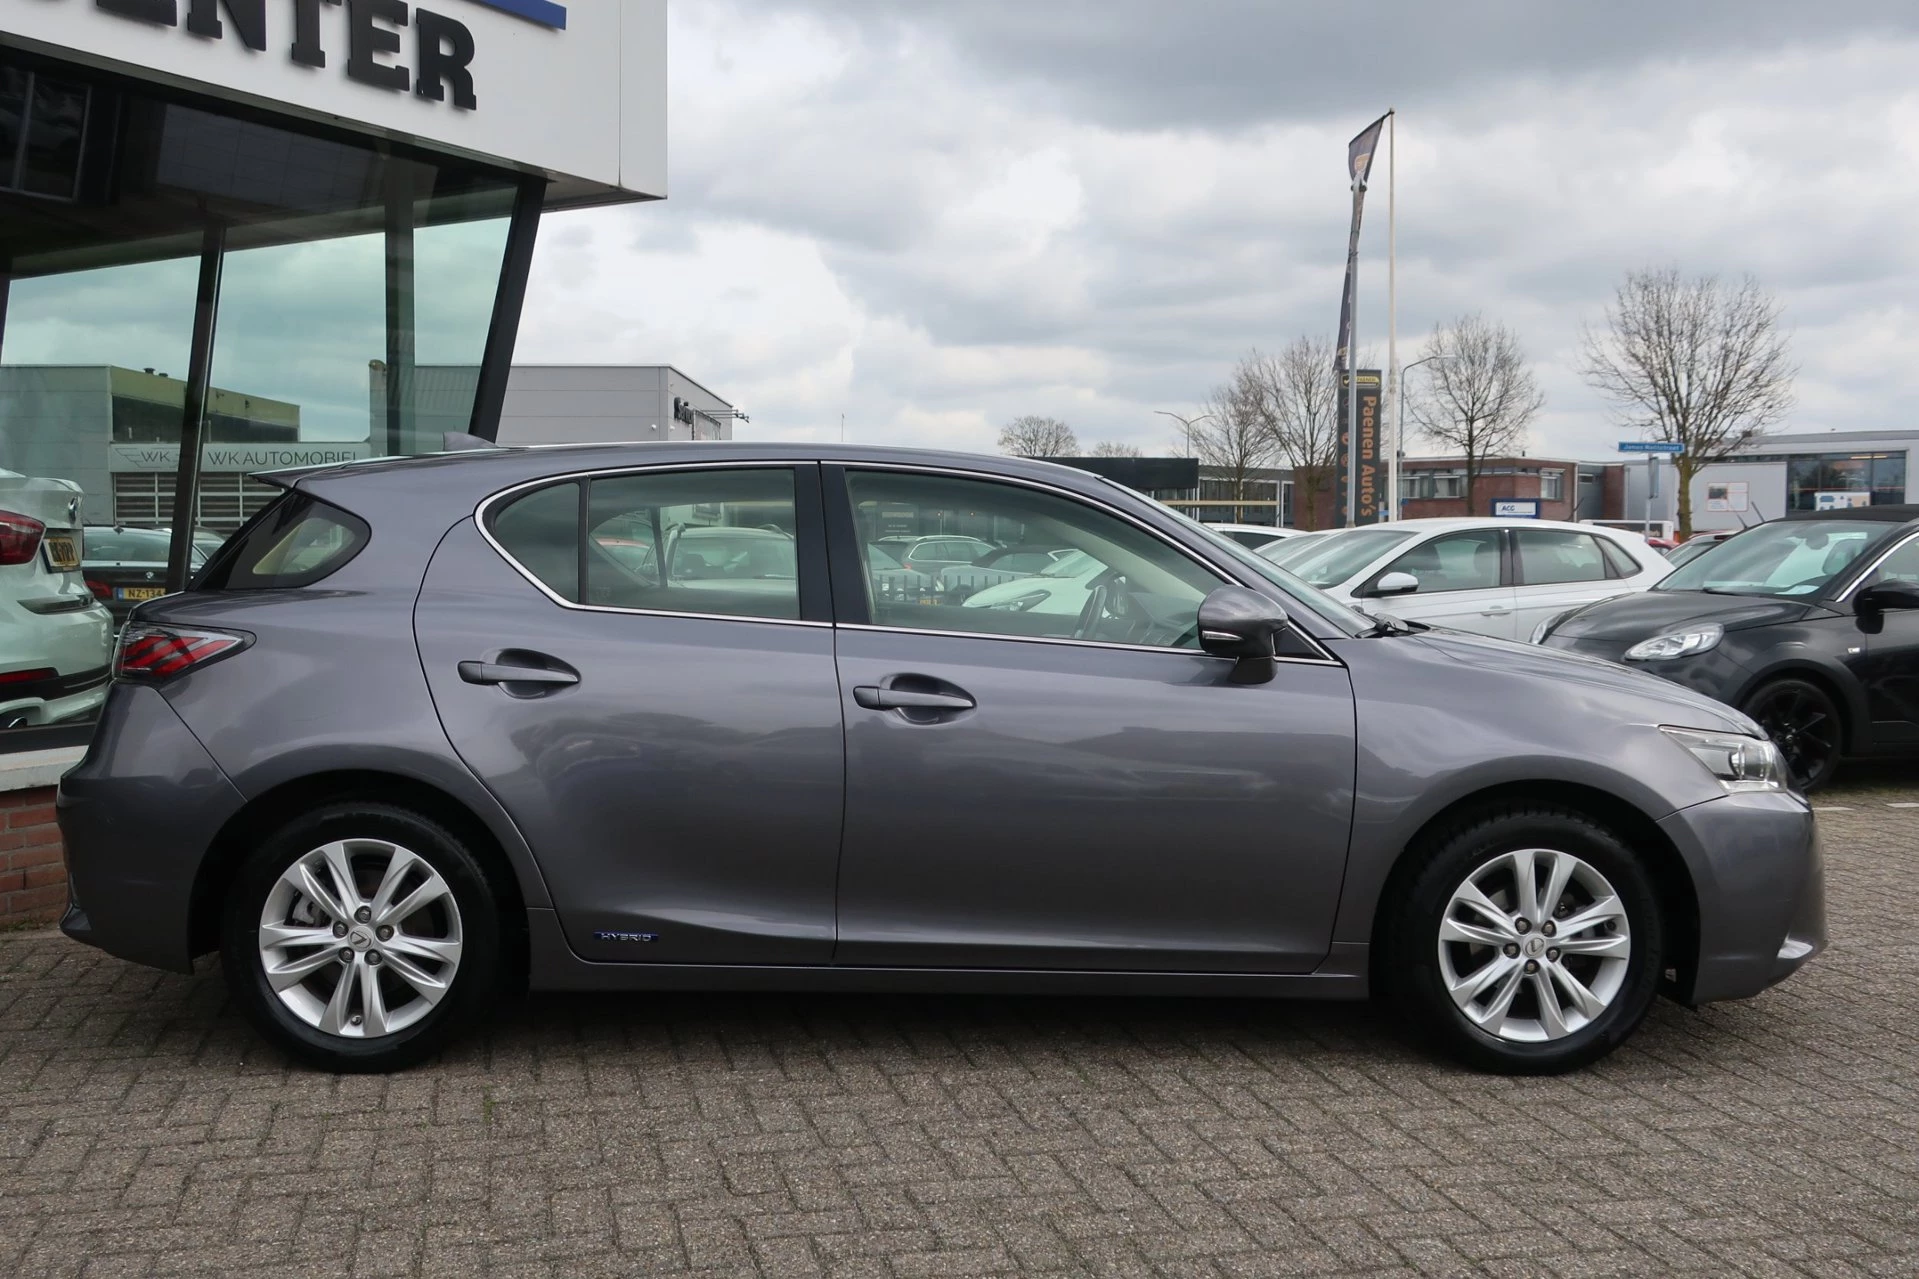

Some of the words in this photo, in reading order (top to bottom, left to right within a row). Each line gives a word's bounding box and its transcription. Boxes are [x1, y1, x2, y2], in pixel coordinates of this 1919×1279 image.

[1362, 396, 1377, 459] Paenen
[141, 452, 170, 462] WK
[208, 452, 240, 465] WK
[1361, 464, 1376, 516] Auto's
[601, 933, 651, 941] HYBRID
